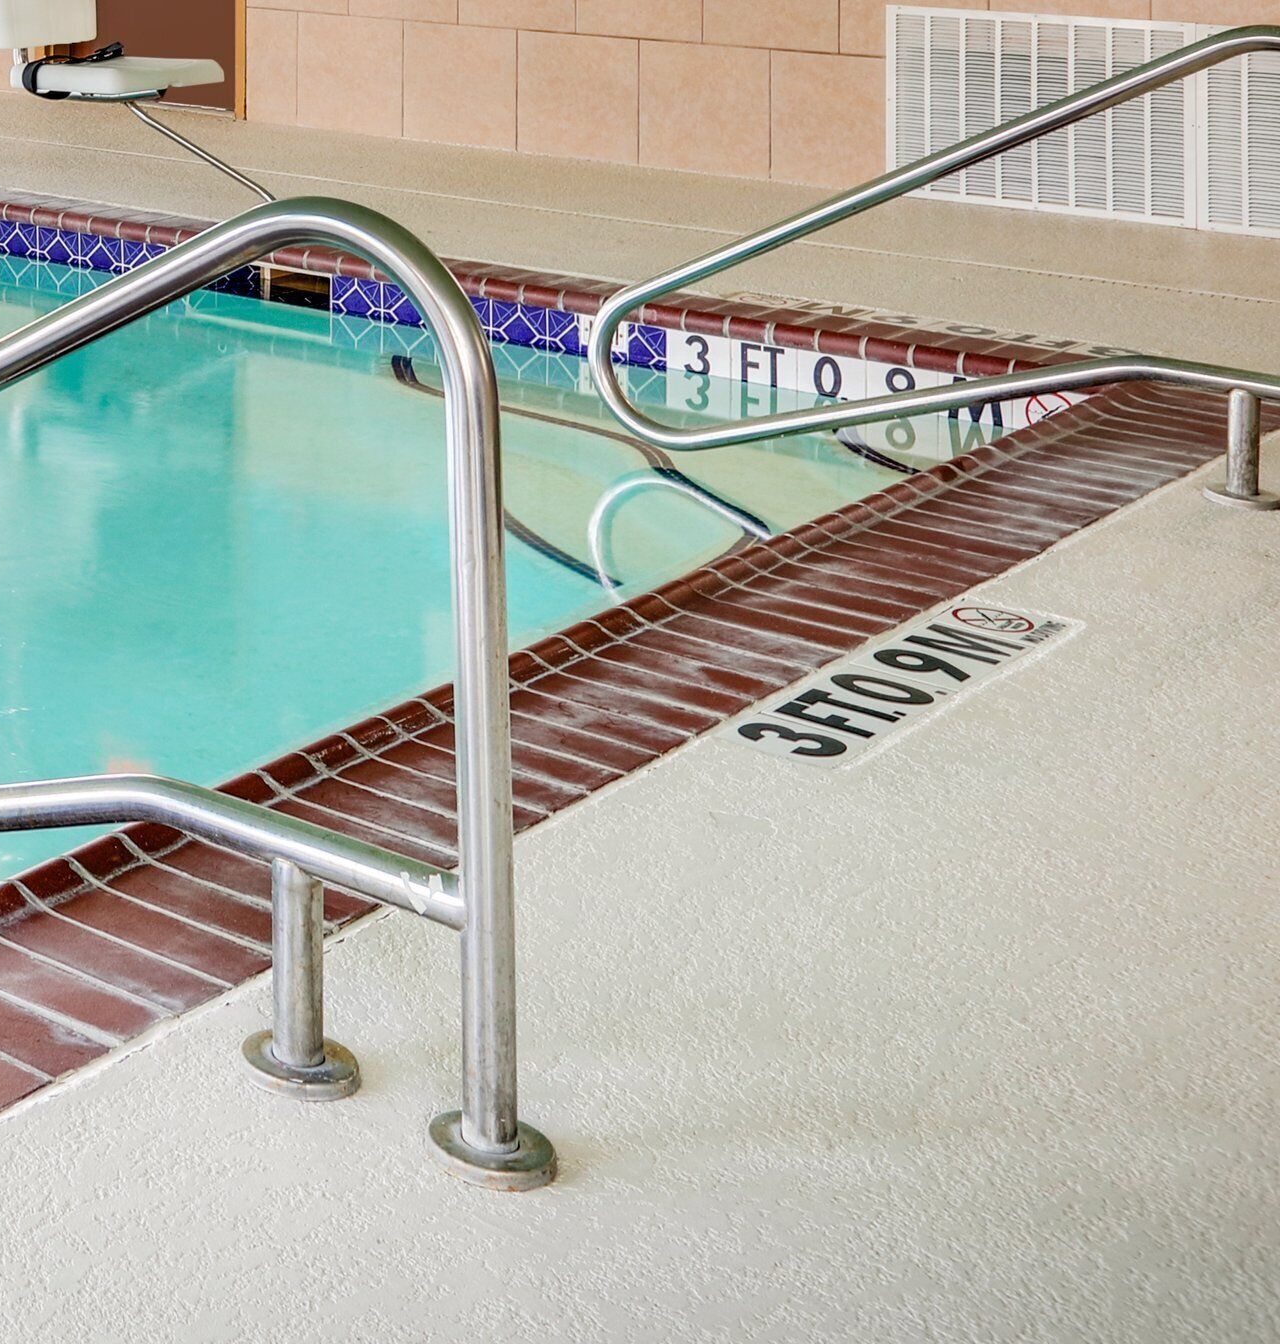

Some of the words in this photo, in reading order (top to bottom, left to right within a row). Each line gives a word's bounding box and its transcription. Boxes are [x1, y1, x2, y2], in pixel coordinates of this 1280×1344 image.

[796, 303, 865, 316] M
[684, 335, 709, 375] 3
[740, 344, 785, 388] FT
[738, 722, 847, 757] 3
[904, 624, 1027, 666] M
